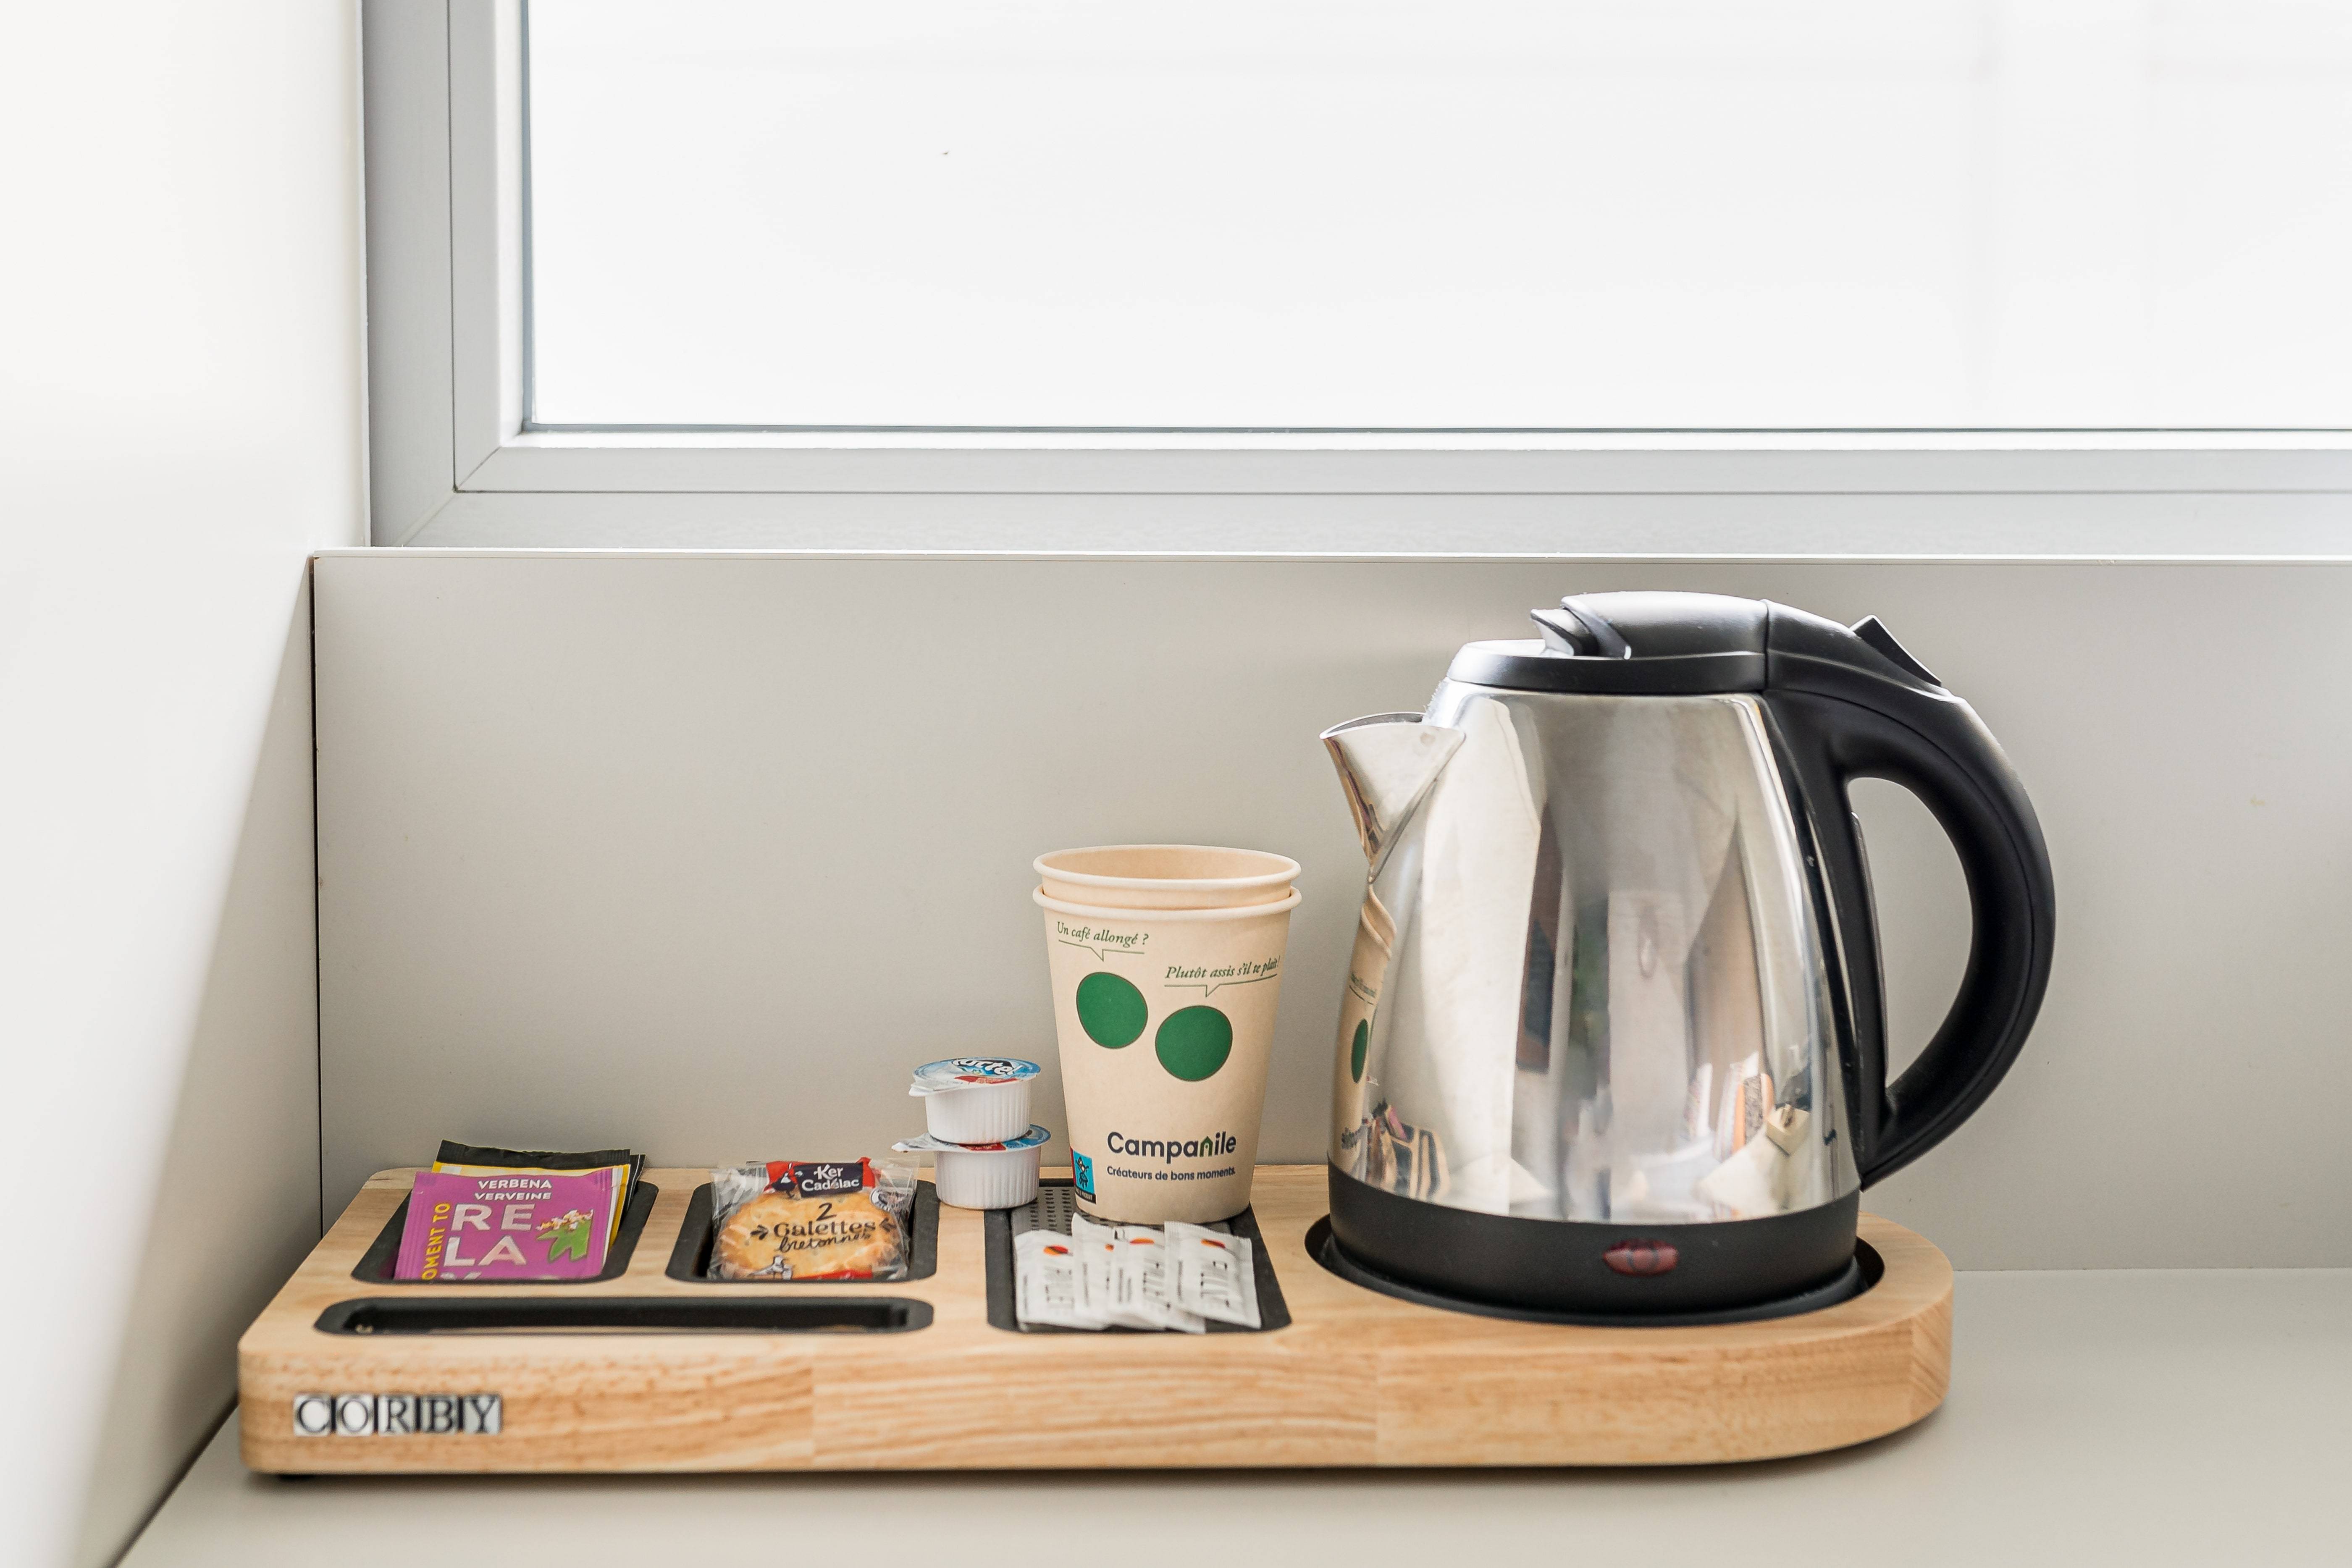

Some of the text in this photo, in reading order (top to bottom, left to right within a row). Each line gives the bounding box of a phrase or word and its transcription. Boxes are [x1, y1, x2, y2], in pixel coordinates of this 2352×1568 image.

[1057, 921, 1069, 935] Un
[1071, 926, 1091, 942] café
[1093, 929, 1139, 948] allongé
[1165, 966, 1208, 979] Plutôt
[1210, 965, 1235, 978] assis
[1253, 965, 1261, 974] te
[1107, 1131, 1237, 1164] Campanile
[813, 1164, 844, 1180] Ker
[1107, 1166, 1152, 1180] Créateurs
[1155, 1170, 1168, 1180] de
[1171, 1170, 1194, 1181] bons
[478, 1178, 553, 1190] VERBENA
[474, 1192, 552, 1201] VERVEINE
[432, 1203, 451, 1223] TO
[450, 1203, 536, 1232] RE
[816, 1202, 837, 1221] 2
[774, 1220, 876, 1238] Galettes
[443, 1235, 527, 1266] LA
[775, 1232, 872, 1253] bretonnes
[298, 1398, 496, 1433] CORBY
